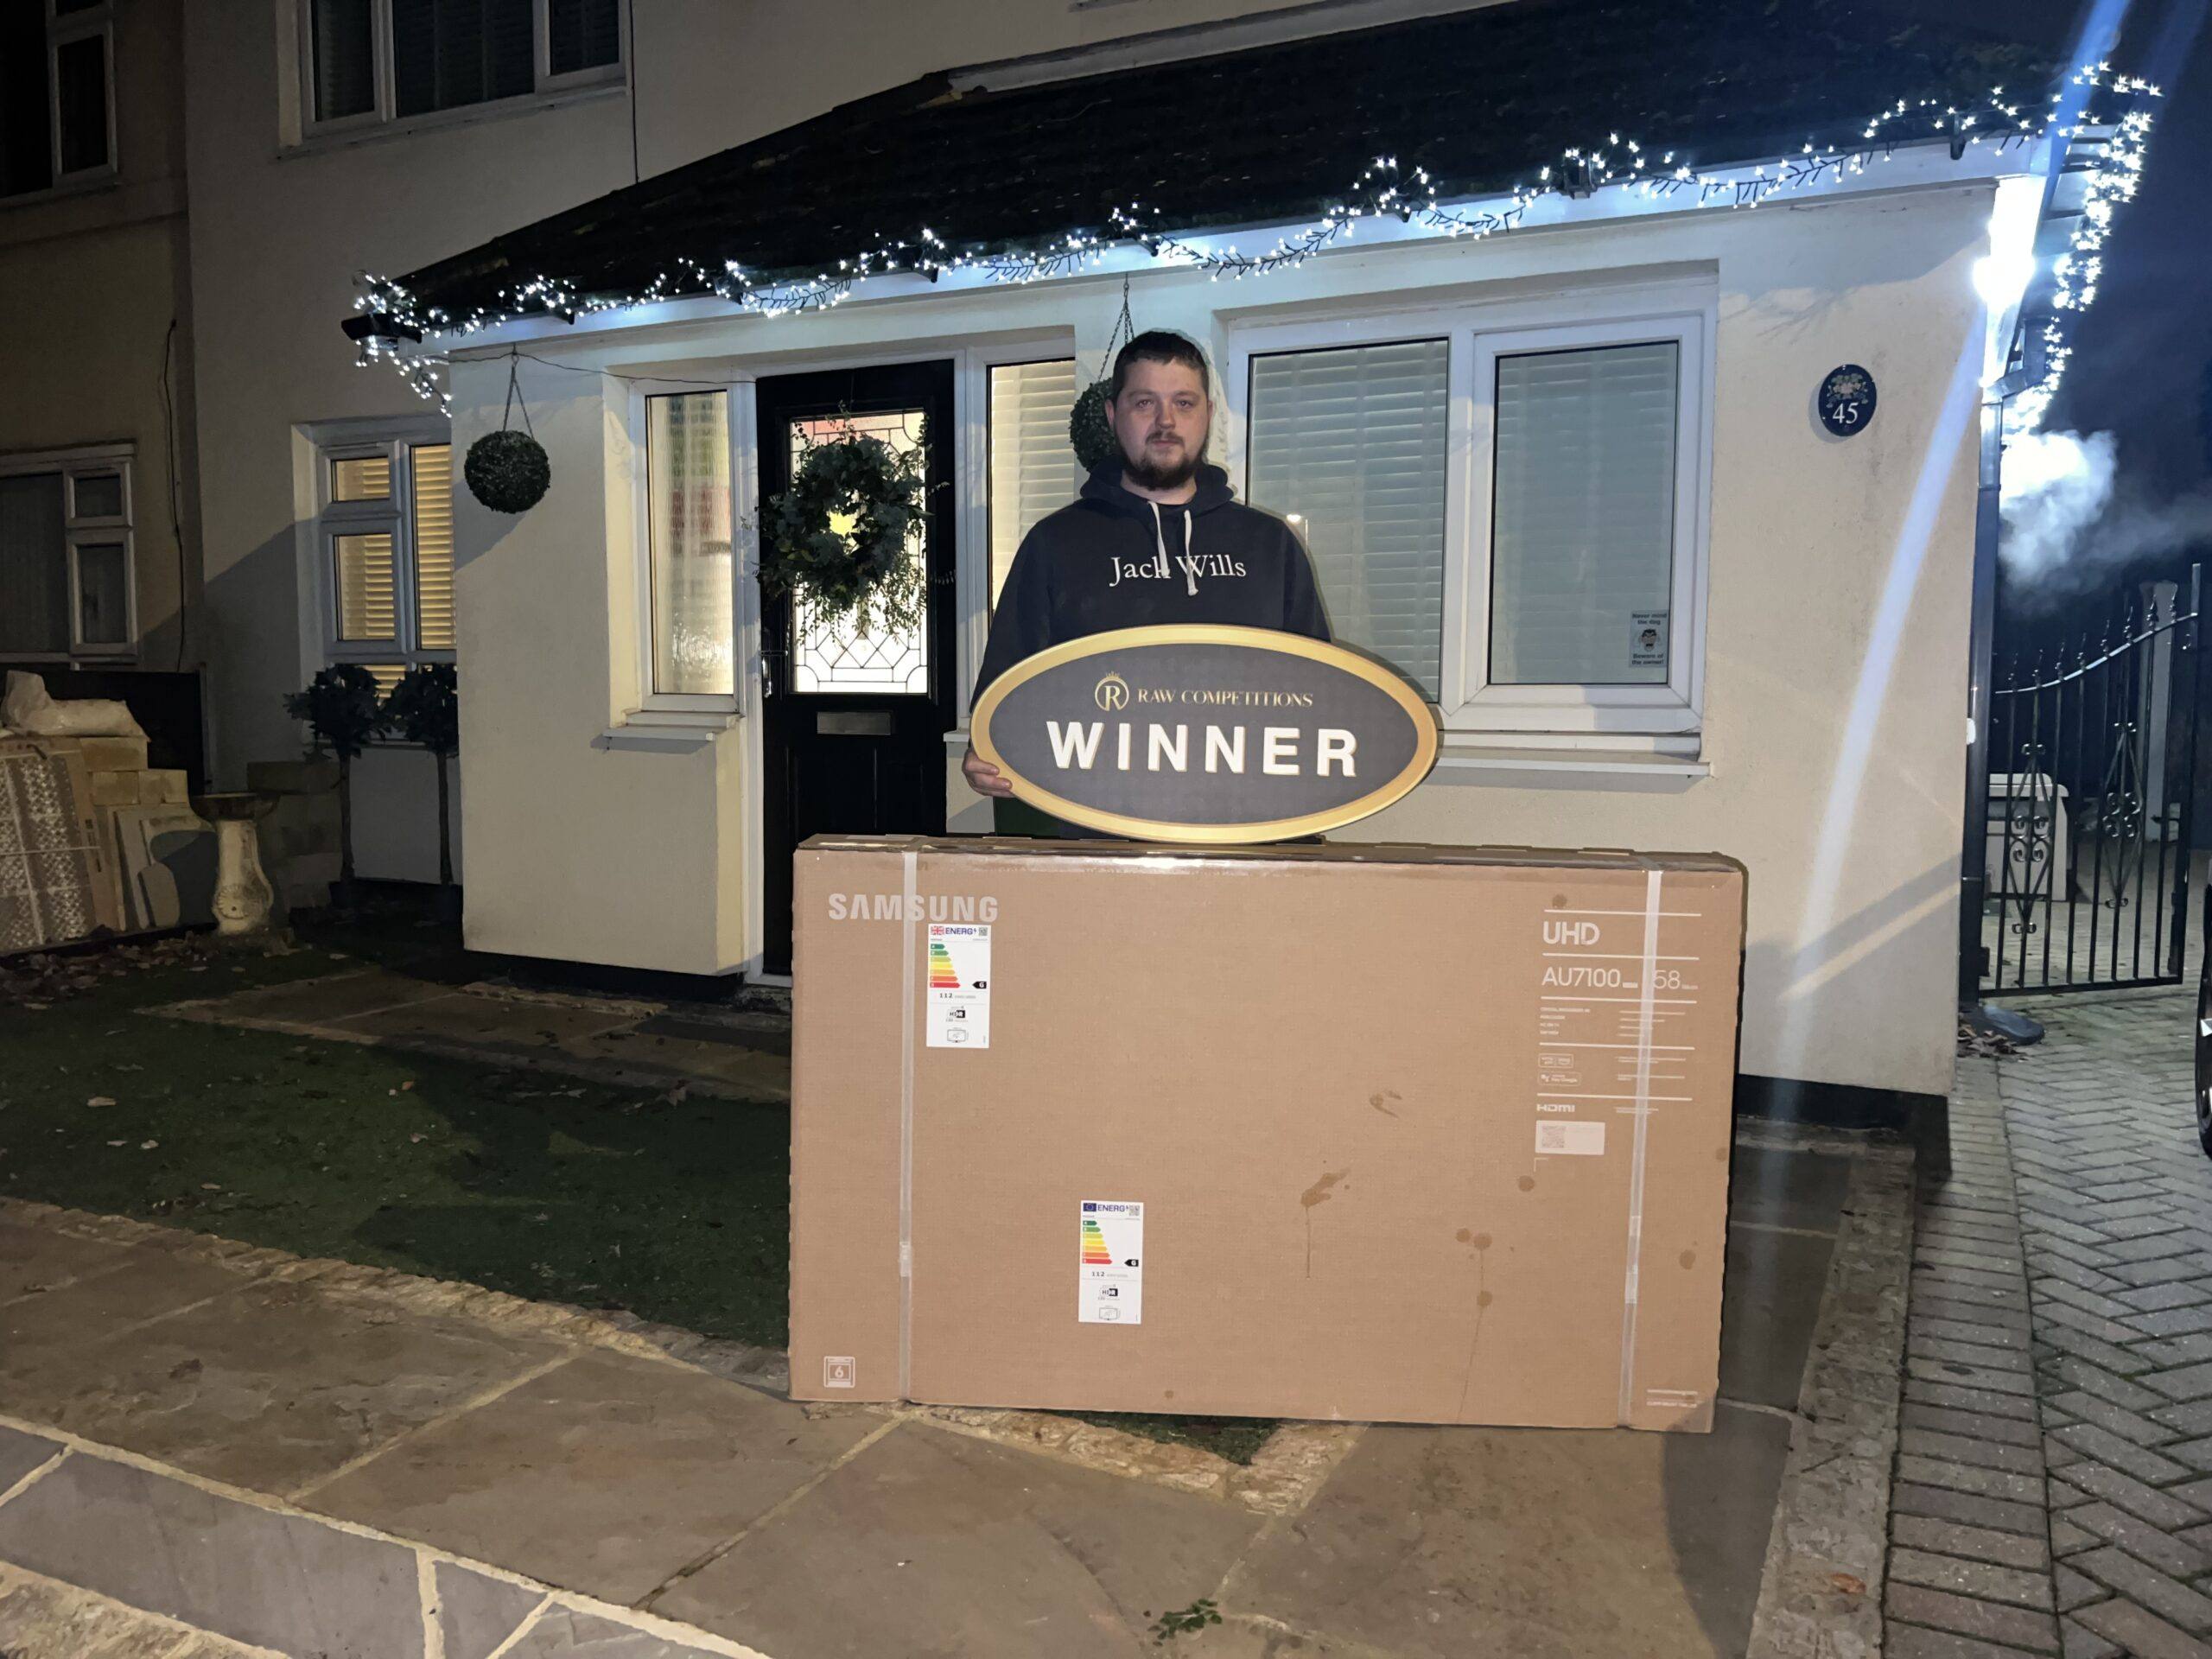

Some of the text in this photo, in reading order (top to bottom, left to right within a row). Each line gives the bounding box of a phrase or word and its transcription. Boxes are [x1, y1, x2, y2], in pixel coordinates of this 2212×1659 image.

[1832, 402, 1859, 424] 45
[1109, 554, 1247, 588] Jack Wills
[1138, 688, 1313, 708] RAW COMPETITIONS
[1046, 721, 1358, 778] WINNER
[828, 893, 998, 922] SAMSUNG
[1543, 921, 1600, 945] UHD
[1541, 967, 1621, 987] AU7100
[1653, 969, 1681, 989] 58
[835, 1365, 844, 1378] 6
